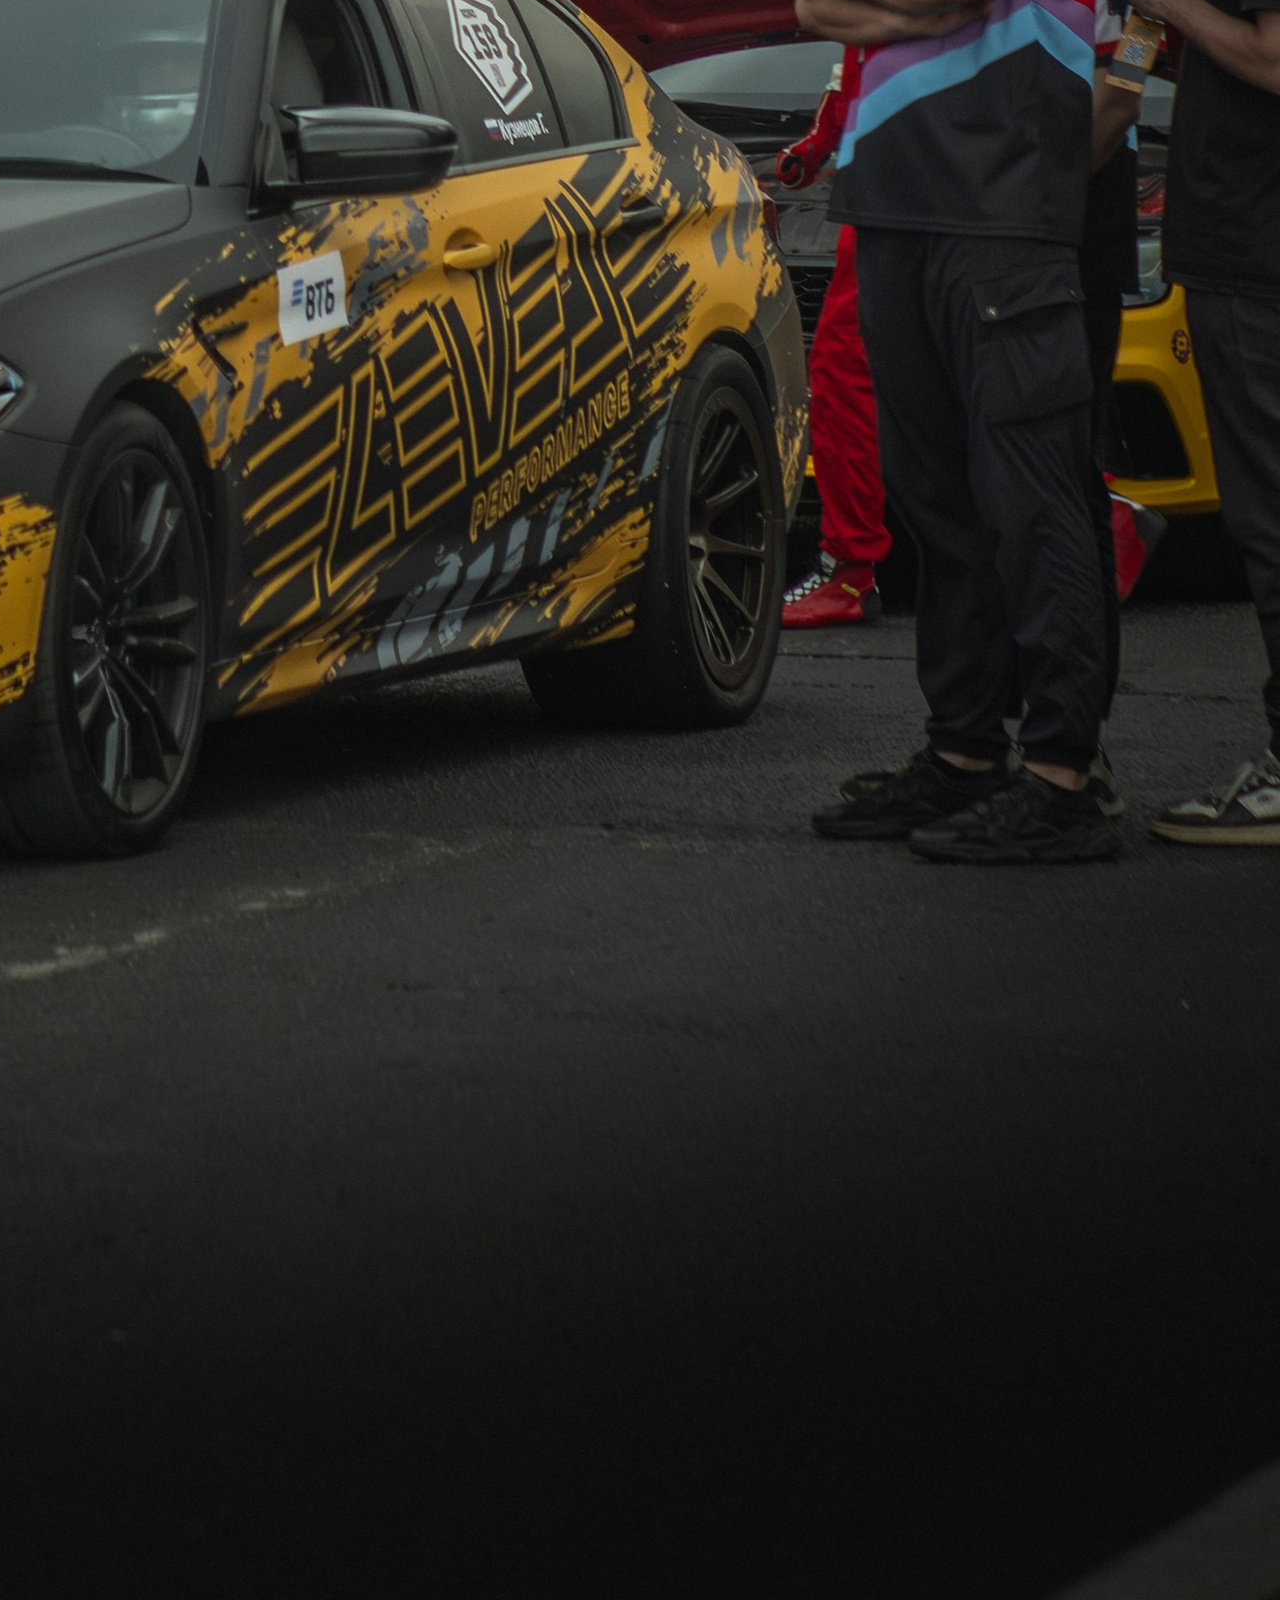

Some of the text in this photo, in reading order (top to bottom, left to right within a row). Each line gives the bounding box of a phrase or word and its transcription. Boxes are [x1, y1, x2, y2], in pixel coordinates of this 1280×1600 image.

[462, 24, 503, 60] 159
[305, 278, 335, 322] ВТБ
[470, 368, 631, 543] PERFORMANCE
